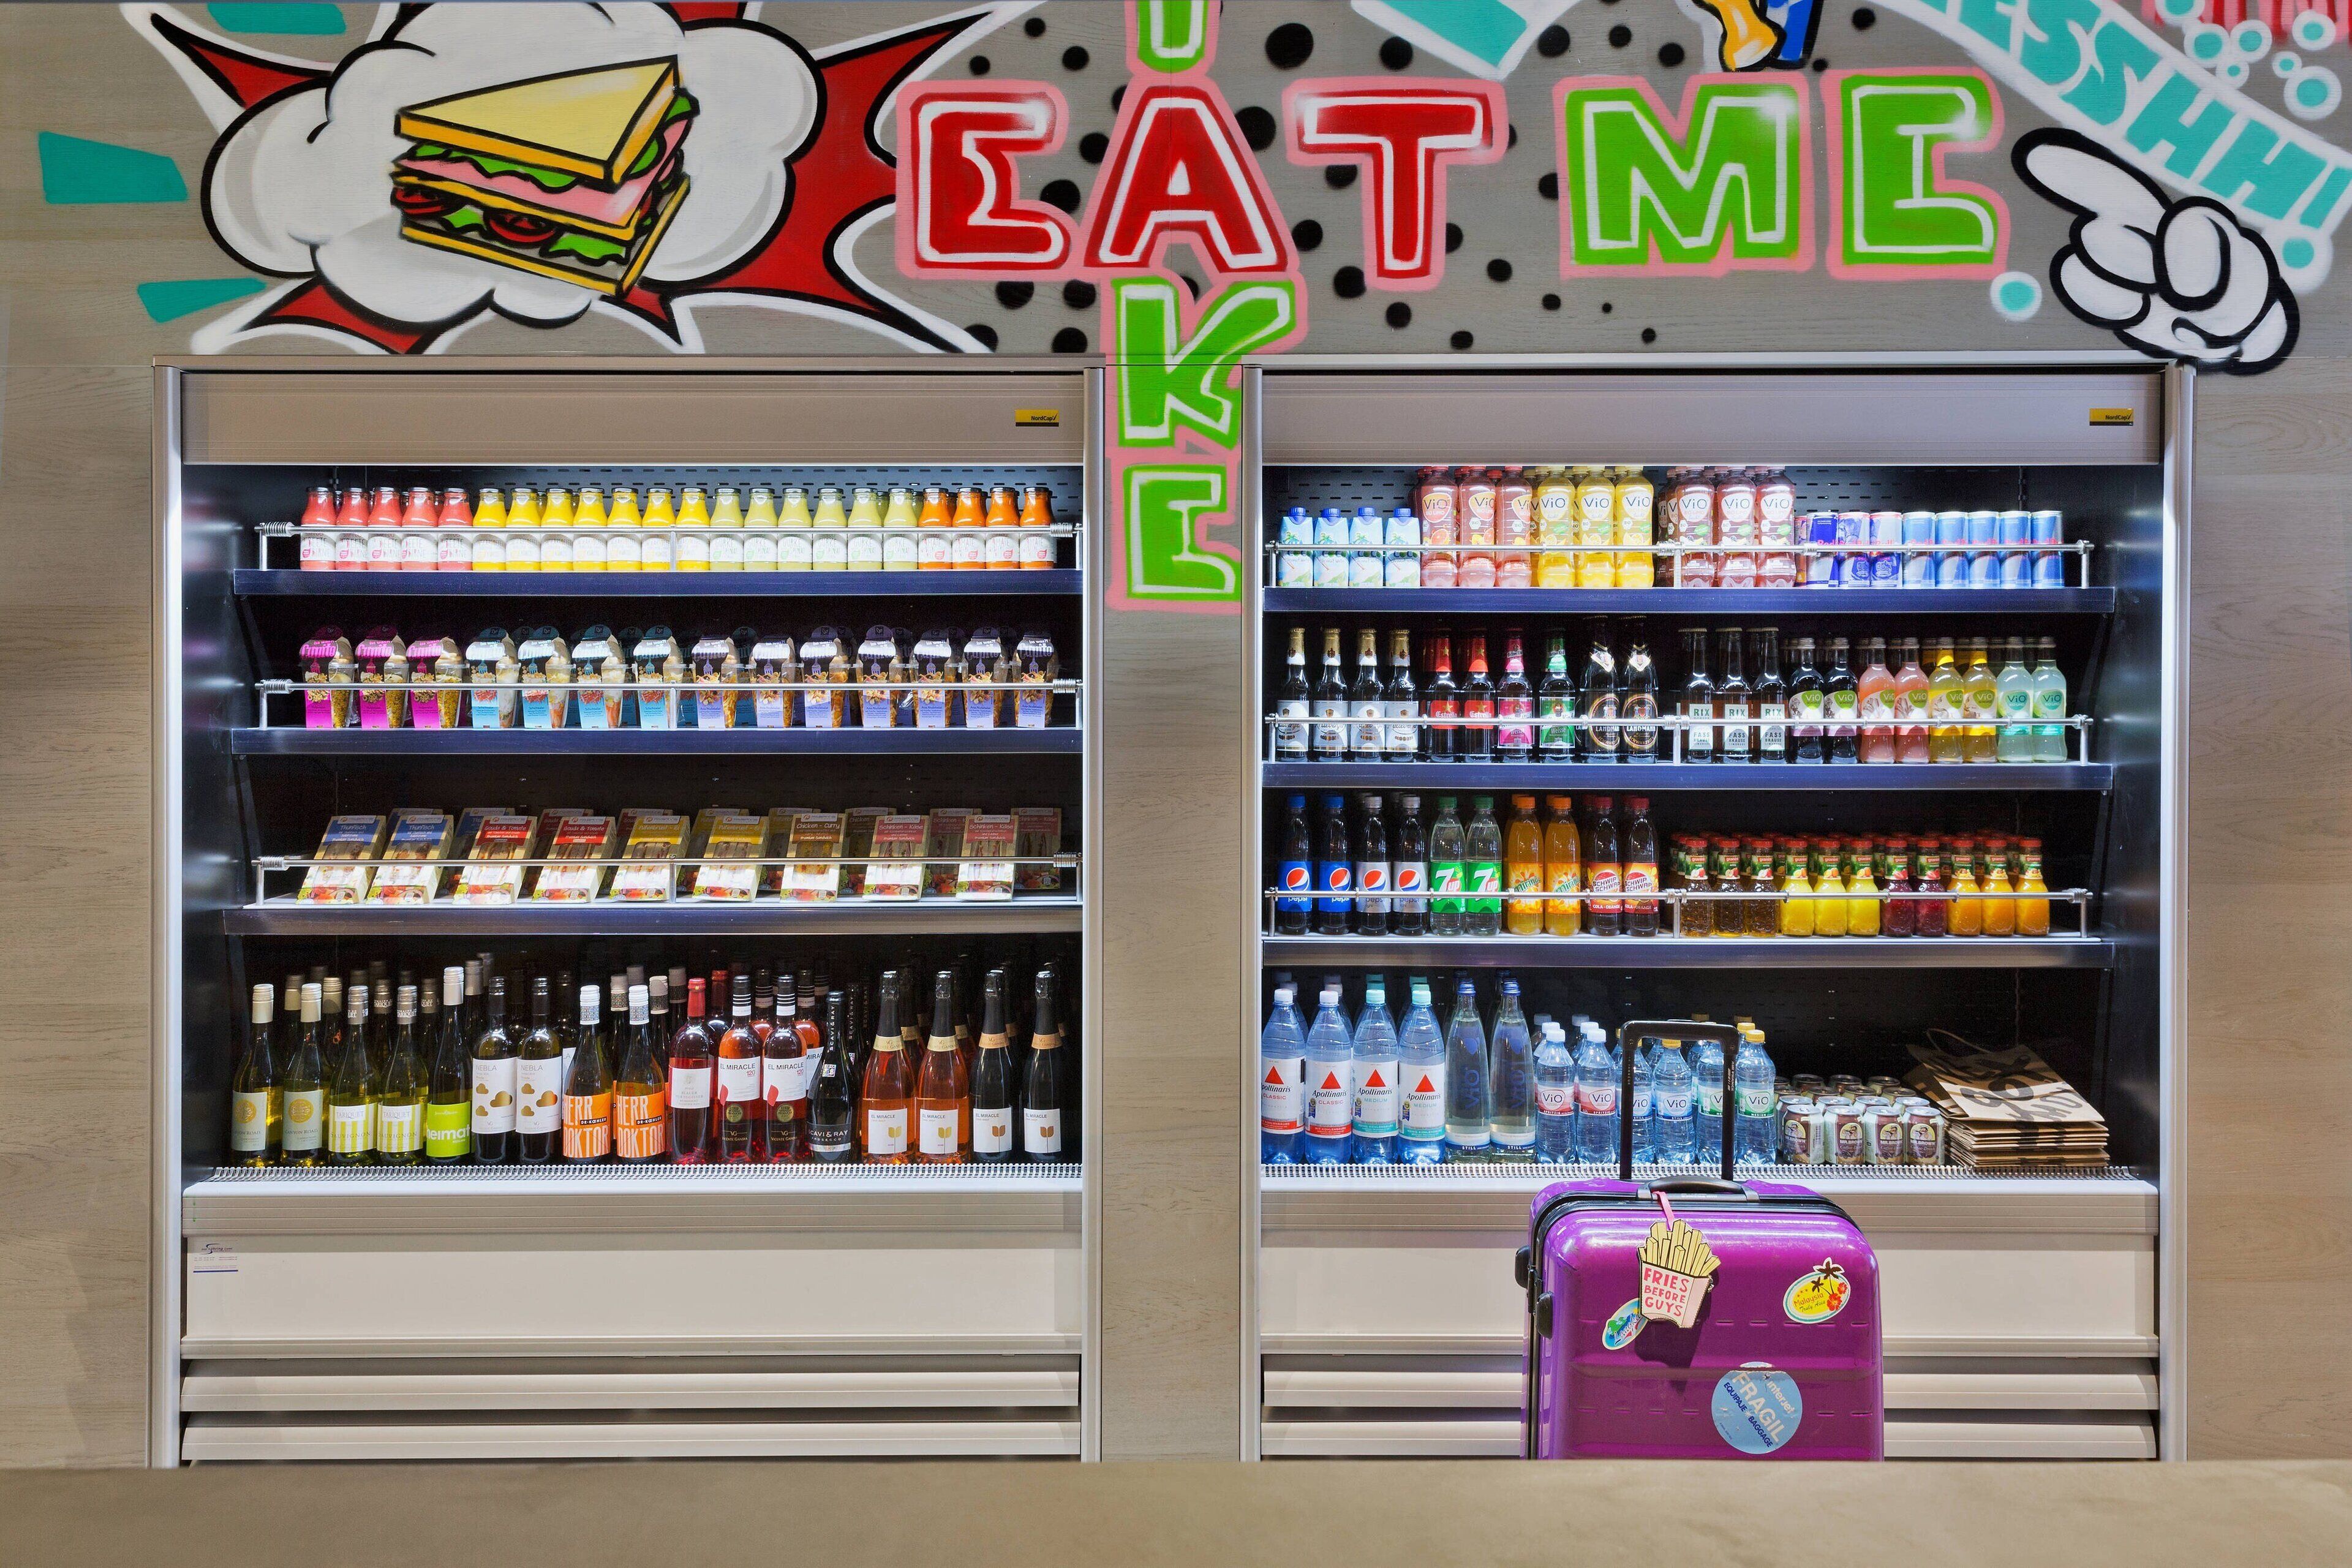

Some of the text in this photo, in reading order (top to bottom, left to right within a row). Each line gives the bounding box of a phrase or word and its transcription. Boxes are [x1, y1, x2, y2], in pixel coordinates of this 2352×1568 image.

[911, 75, 1999, 277] EAT ME
[1541, 498, 1566, 508] ViO
[1584, 498, 1609, 508] ViO
[1626, 497, 1651, 507] ViO
[1681, 499, 1707, 510] ViO
[1724, 499, 1751, 510] ViO
[1763, 499, 1790, 509] ViO
[1593, 877, 1617, 886] SCHWIP
[1625, 877, 1647, 886] SCHWIP
[1595, 882, 1621, 892] SCHWAP
[1626, 882, 1653, 892] SCHWAP
[1261, 1084, 1291, 1093] pollinaris
[1313, 1090, 1347, 1098] Apollinaris
[1543, 1093, 1562, 1102] ViO
[1593, 1093, 1611, 1102] ViO
[1667, 1099, 1687, 1108] ViO
[1749, 1096, 1769, 1105] ViO
[564, 1096, 593, 1126] HERR
[617, 1096, 649, 1126] HERR
[564, 1125, 609, 1158] DOKTOR
[617, 1123, 665, 1158] DOKTOR
[1643, 1267, 1689, 1293] FRIES
[1644, 1286, 1686, 1303] BEFORE
[1794, 1292, 1824, 1307] Malaysia
[1645, 1297, 1684, 1317] GUYS
[1732, 1372, 1785, 1443] FRAGIL
[1724, 1382, 1747, 1412] EQUIPAJE
[1748, 1415, 1773, 1447] BAGGAGE
